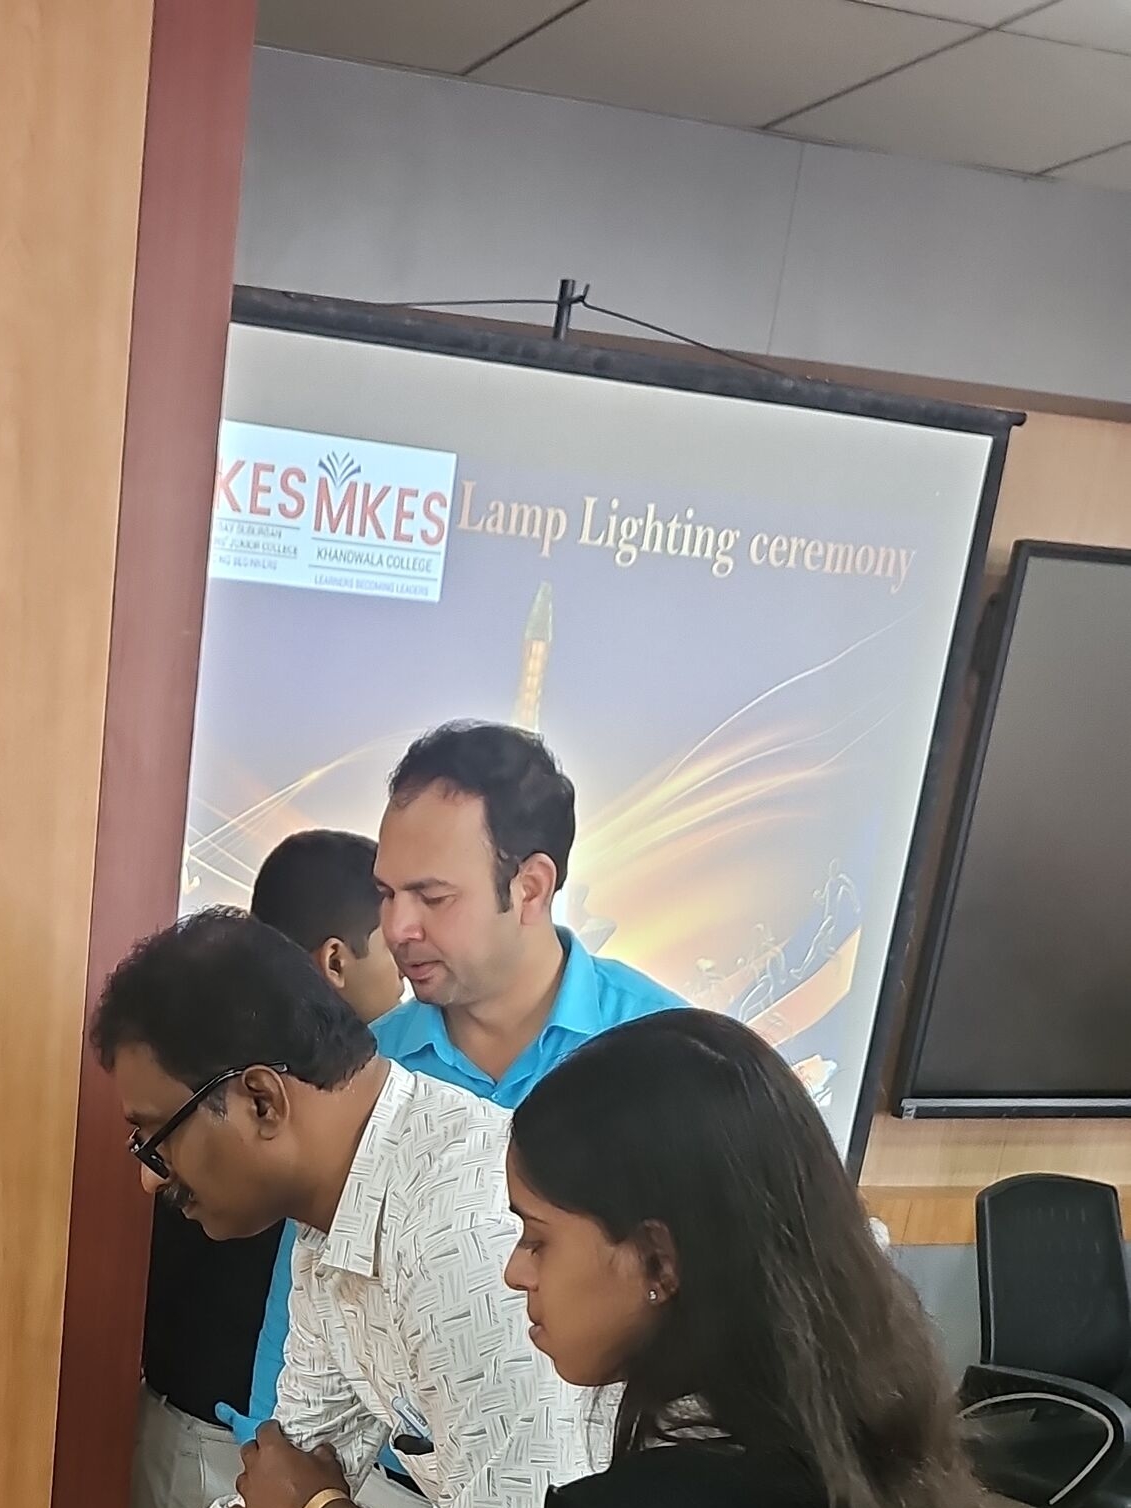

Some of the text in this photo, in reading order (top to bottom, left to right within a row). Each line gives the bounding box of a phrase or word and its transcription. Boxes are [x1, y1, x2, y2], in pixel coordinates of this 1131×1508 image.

[313, 476, 448, 546] MKES
[457, 480, 916, 594] Lamp Lighting ceremony
[386, 553, 433, 573] COLLEGE
